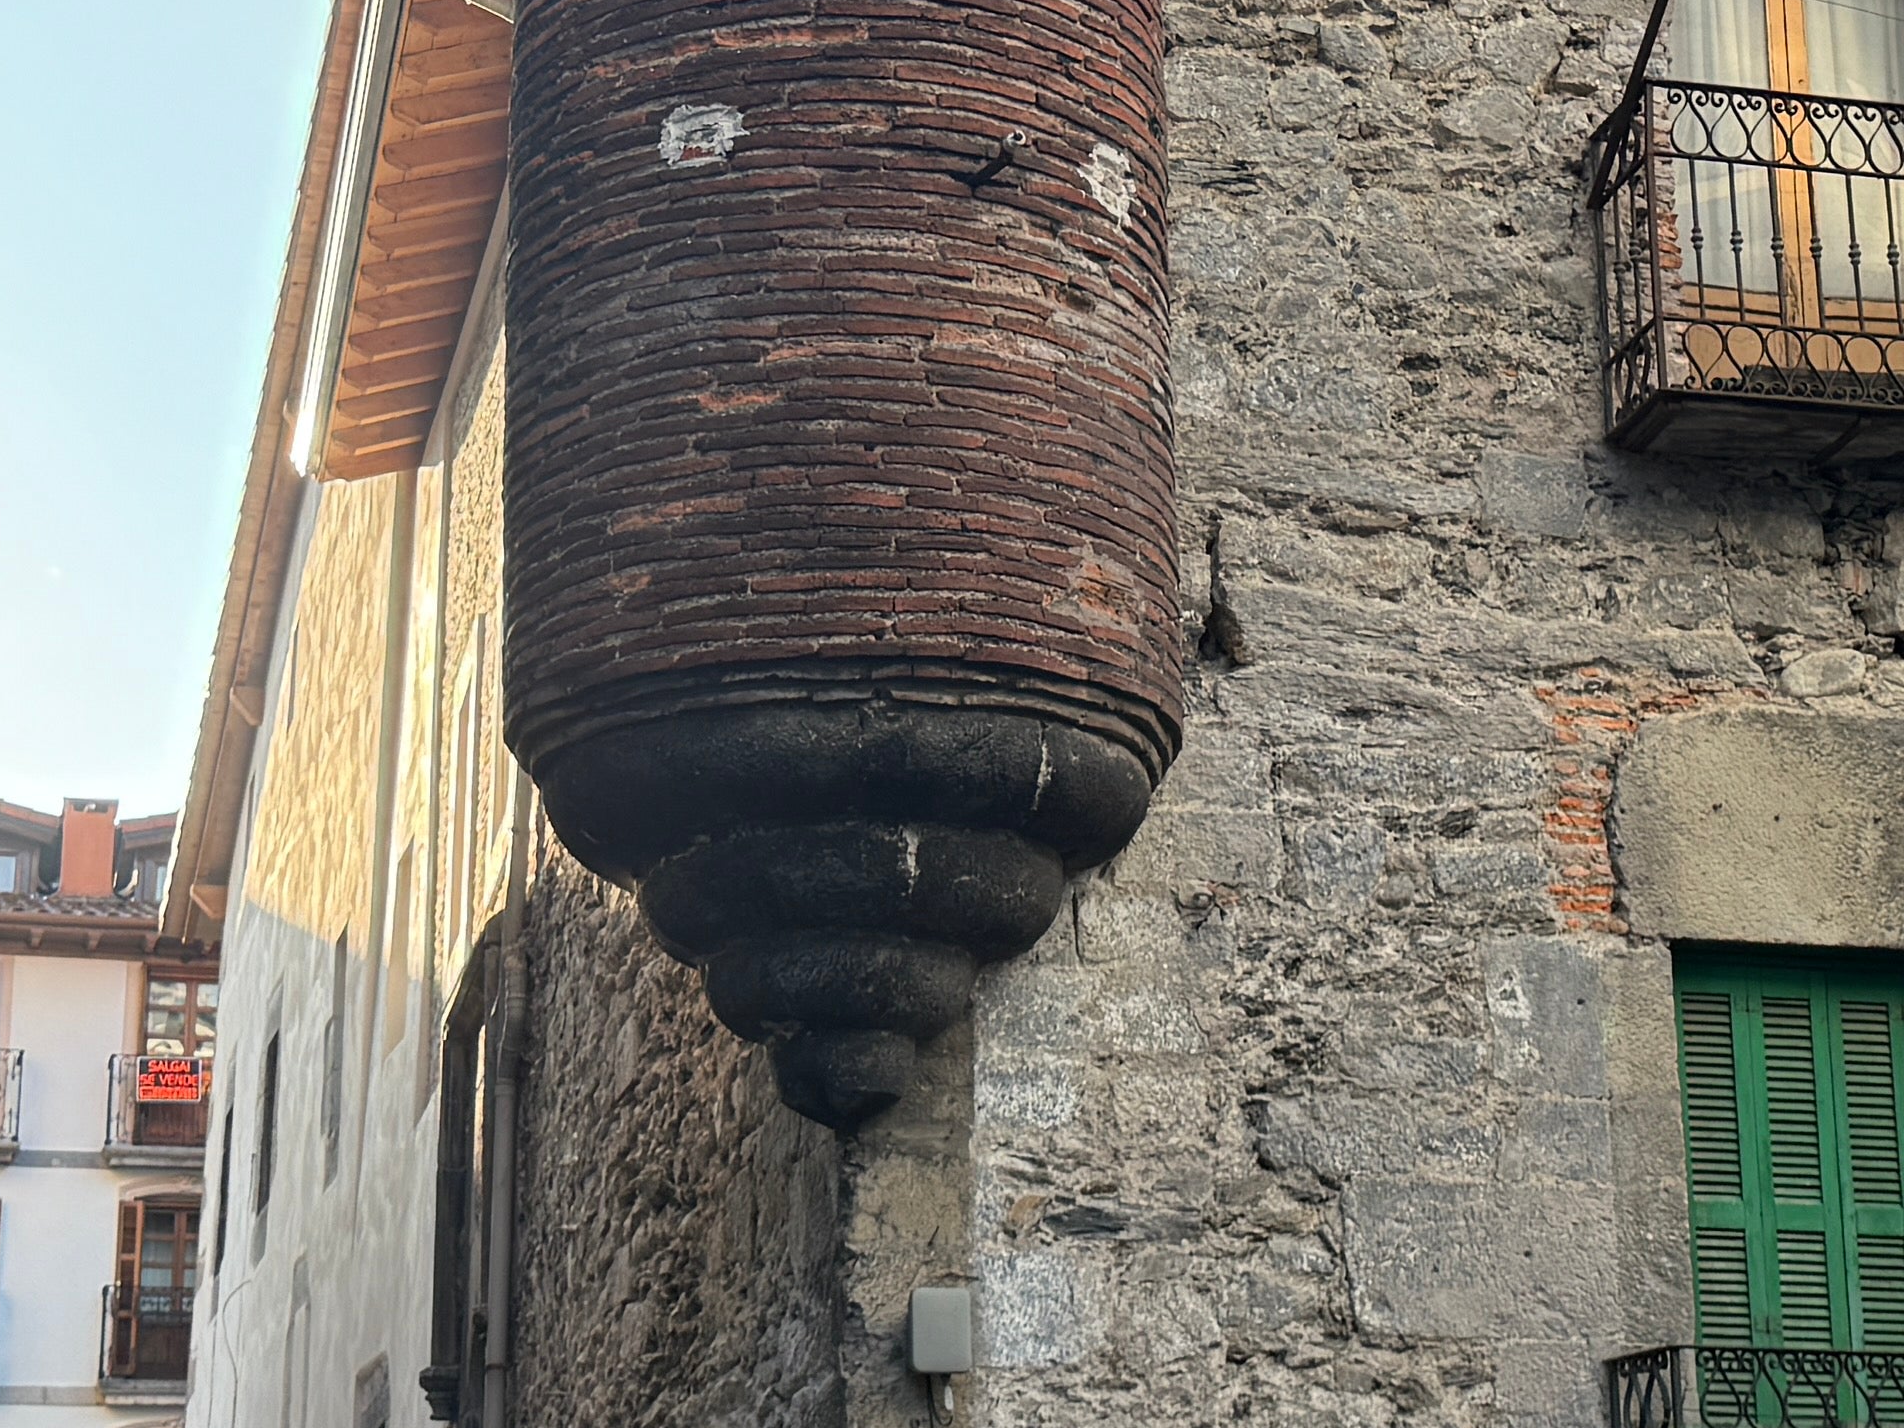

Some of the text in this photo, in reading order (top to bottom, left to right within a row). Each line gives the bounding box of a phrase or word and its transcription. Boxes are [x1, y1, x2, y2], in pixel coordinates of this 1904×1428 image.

[148, 1059, 191, 1073] SALGAI
[140, 1073, 199, 1086] SE VENDE
